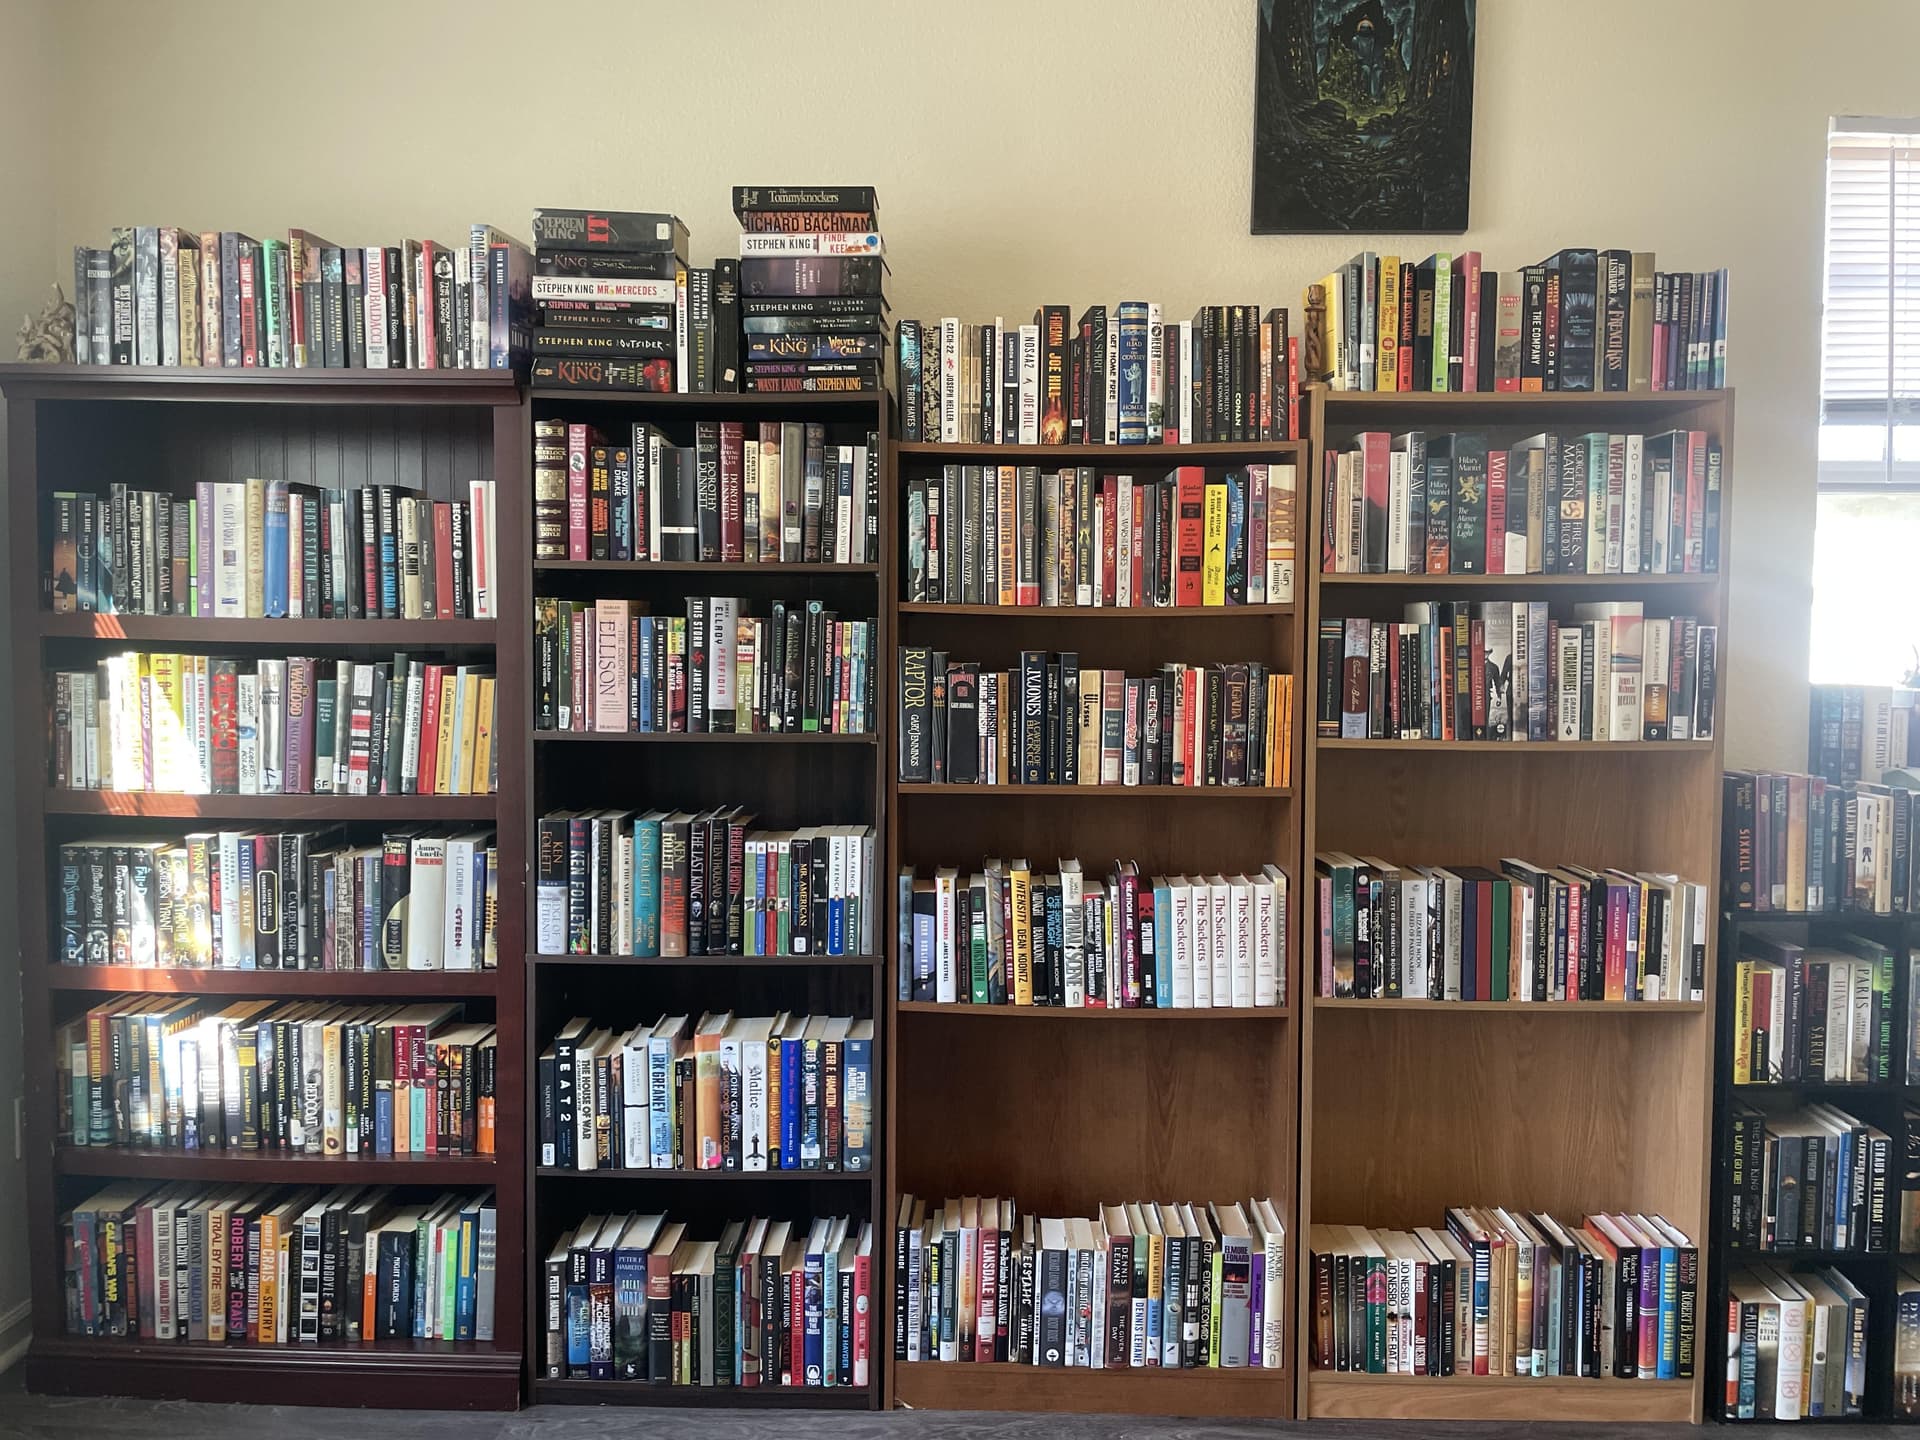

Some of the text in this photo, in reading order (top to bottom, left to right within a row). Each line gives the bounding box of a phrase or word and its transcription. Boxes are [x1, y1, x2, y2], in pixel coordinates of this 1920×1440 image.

[768, 191, 839, 203] Tommyknockers
[533, 217, 584, 232] STEPHEN
[544, 229, 576, 239] KING
[747, 239, 810, 249] STEPHEN KING
[804, 218, 870, 231] BACHMAN
[554, 254, 587, 268] KING
[368, 262, 381, 344] DAVID BALDACCI
[537, 283, 572, 293] STEPHEN
[575, 284, 593, 294] KING
[616, 286, 657, 296] MERCEDES
[539, 337, 613, 347] STEPHEN KING
[769, 339, 807, 354] KING
[1024, 337, 1034, 368] NOS4A2
[1093, 309, 1103, 375] MEAN SPIRIT
[1531, 311, 1541, 365] THE COMPANY
[1605, 311, 1624, 370] FRENCH KISS
[558, 361, 602, 383] KING
[817, 377, 861, 390] STEPHEN KING
[1048, 353, 1061, 398] JOE HILL
[907, 384, 915, 427] TERRY HAYES
[1024, 393, 1035, 429] JOE HILL
[637, 458, 645, 486] DRAKE
[708, 462, 716, 512] DOROTHY
[1492, 456, 1505, 520] Wolf Hall
[1563, 444, 1574, 497] MARTIN
[1609, 443, 1623, 495] WEAPON
[160, 498, 169, 559] CLIVE BARKER
[452, 503, 461, 547] BEOWULF
[1002, 471, 1012, 591] STEPHEN HUNTER HAVANA
[1063, 475, 1074, 581] The Master Sniper
[1562, 523, 1571, 556] BLOOD
[1573, 522, 1582, 555] FIRE &
[1273, 562, 1282, 594] Jennings
[1282, 569, 1292, 586] Gary
[694, 601, 703, 647] THIS STORM
[715, 607, 723, 645] ELLROY
[599, 621, 615, 695] ELLISON
[905, 650, 926, 708] RAPTOR
[1563, 646, 1577, 691] ULTRAMARINES
[693, 669, 701, 718] JAMES ELLROY
[988, 677, 996, 737] CRAIG JOHNSON
[372, 713, 382, 764] SLEWFOOT
[979, 700, 987, 736] JOHNSON
[241, 844, 249, 896] KUSHIEL'S
[542, 831, 551, 874] FOLLETT
[553, 841, 563, 863] KEN
[640, 828, 651, 897] KEN FOLLETT
[663, 832, 675, 870] FOLLETT
[675, 840, 685, 862] KEN
[691, 831, 704, 898] THE LAST KING
[1740, 829, 1750, 872] SIXKILL
[571, 850, 584, 935] KEN FOLLETT
[455, 908, 463, 947] CYTEEN
[1016, 880, 1028, 983] INTENSITY DEAN KOONTZ
[1066, 904, 1082, 987] PRIMAL SCENE
[1177, 897, 1188, 960] The Sacketts
[1197, 896, 1208, 961] The Sacketts
[1216, 896, 1226, 958] The Sacketts
[1239, 896, 1249, 958] The Sacketts
[1261, 895, 1271, 957] The Sacketts
[1856, 969, 1869, 1009] PARIS
[560, 1047, 571, 1105] HEAT
[652, 1072, 666, 1112] GREANEY
[750, 1066, 761, 1109] Malice
[582, 1060, 591, 1140] THE HOUSE OF WAR
[1872, 1142, 1884, 1223] STRAUB THE THROAT
[212, 1215, 222, 1289] TRIAL BY FIRE
[232, 1218, 243, 1269] ROBERT
[263, 1220, 274, 1330] ROBERT CRAIS SENTRY
[982, 1243, 996, 1293] LANSDALE
[231, 1292, 242, 1328] CRAIS
[1682, 1291, 1694, 1322] ROBERT
[843, 1326, 848, 1337] MO
[1133, 1303, 1144, 1363] DENNIS LEHANE
[1680, 1333, 1691, 1364] PARKER
[1744, 1314, 1756, 1385] AURORARAMA
